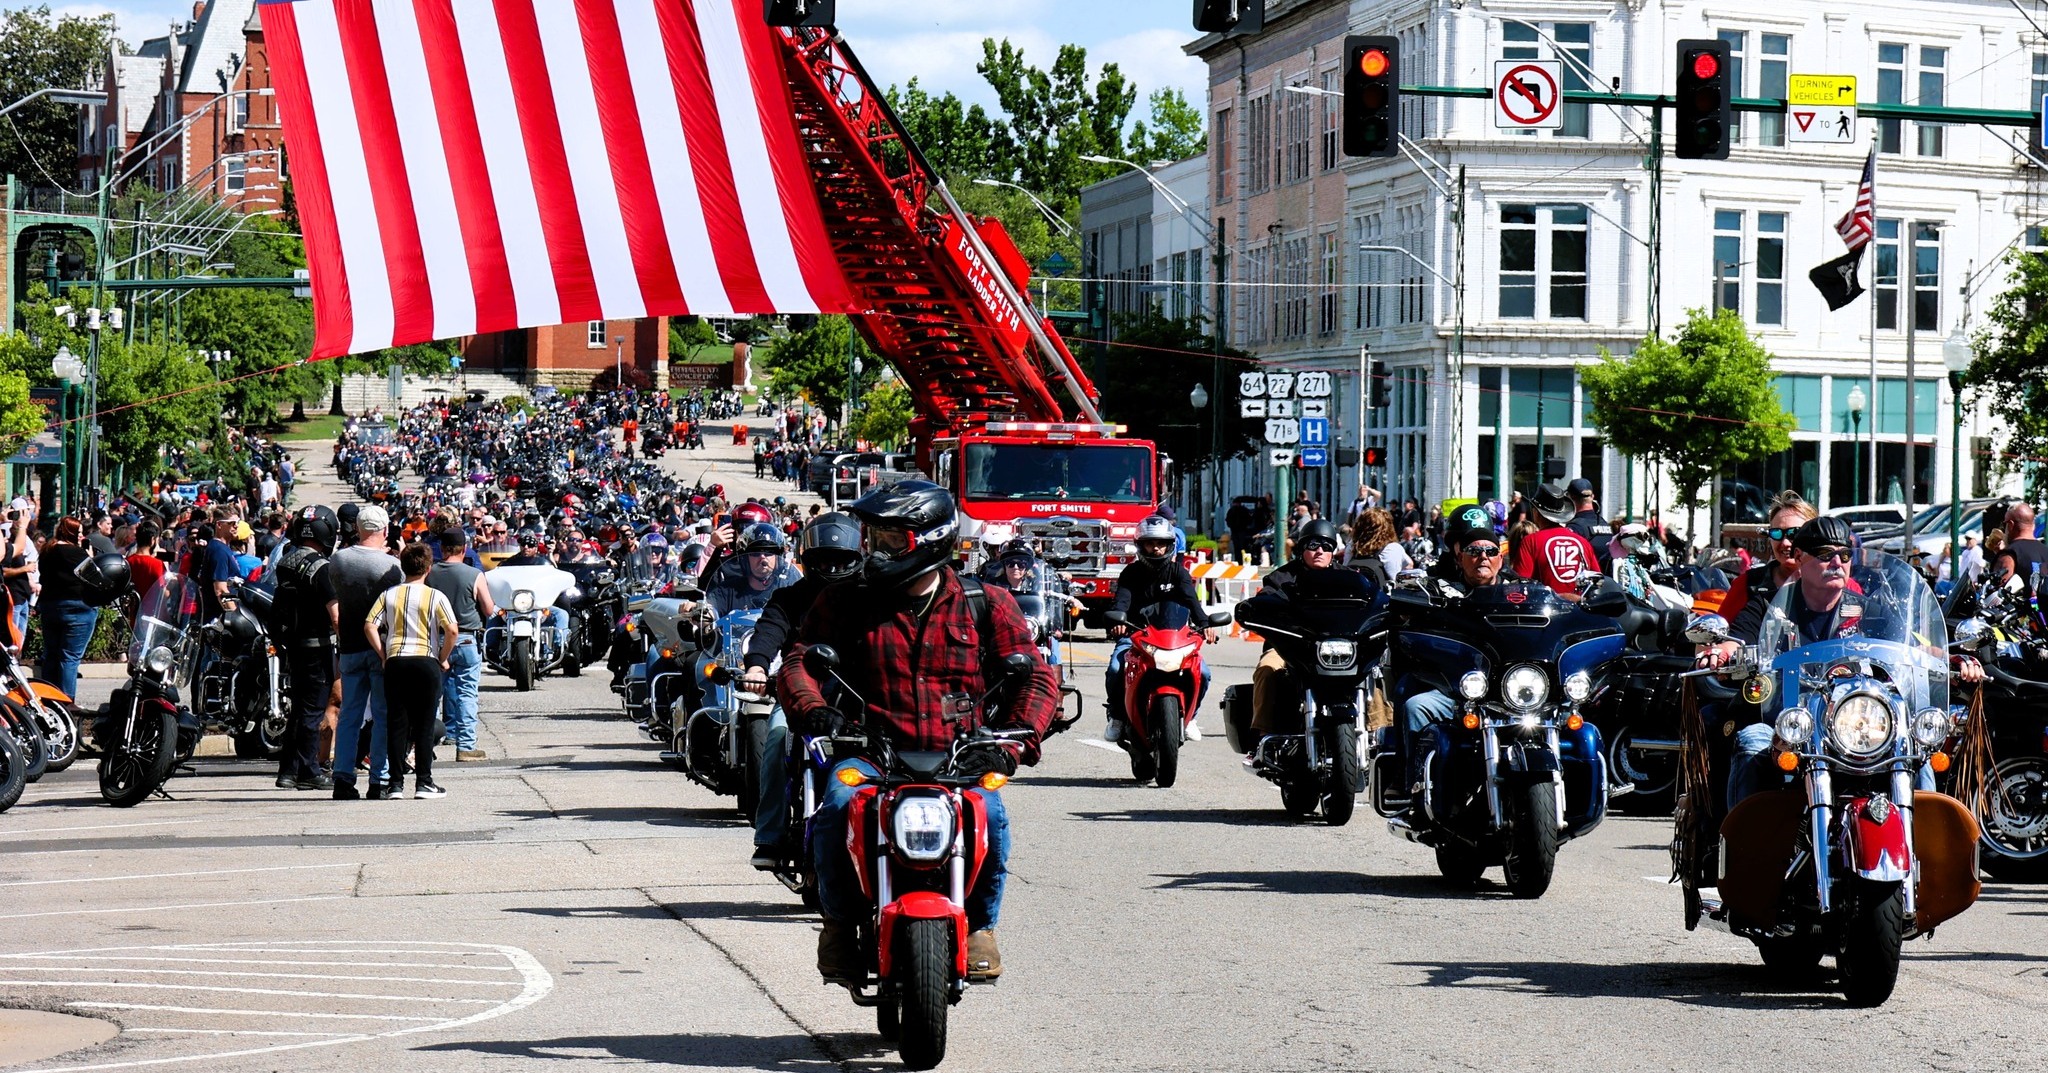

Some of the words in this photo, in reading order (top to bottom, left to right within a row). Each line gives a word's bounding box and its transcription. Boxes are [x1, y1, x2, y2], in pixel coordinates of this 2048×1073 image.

[1795, 80, 1833, 88] TURNING
[1793, 92, 1834, 100] VEHICLES
[1819, 120, 1830, 128] TO
[958, 233, 988, 278] FORT
[988, 278, 1021, 332] SMITH
[967, 267, 997, 314] LADDER
[995, 310, 1003, 323] 3
[1243, 377, 1261, 392] 64
[1302, 377, 1325, 392] 271
[1306, 421, 1323, 442] H
[1031, 504, 1057, 512] FORT
[1060, 504, 1091, 513] SMITH
[1553, 546, 1579, 567] 112
